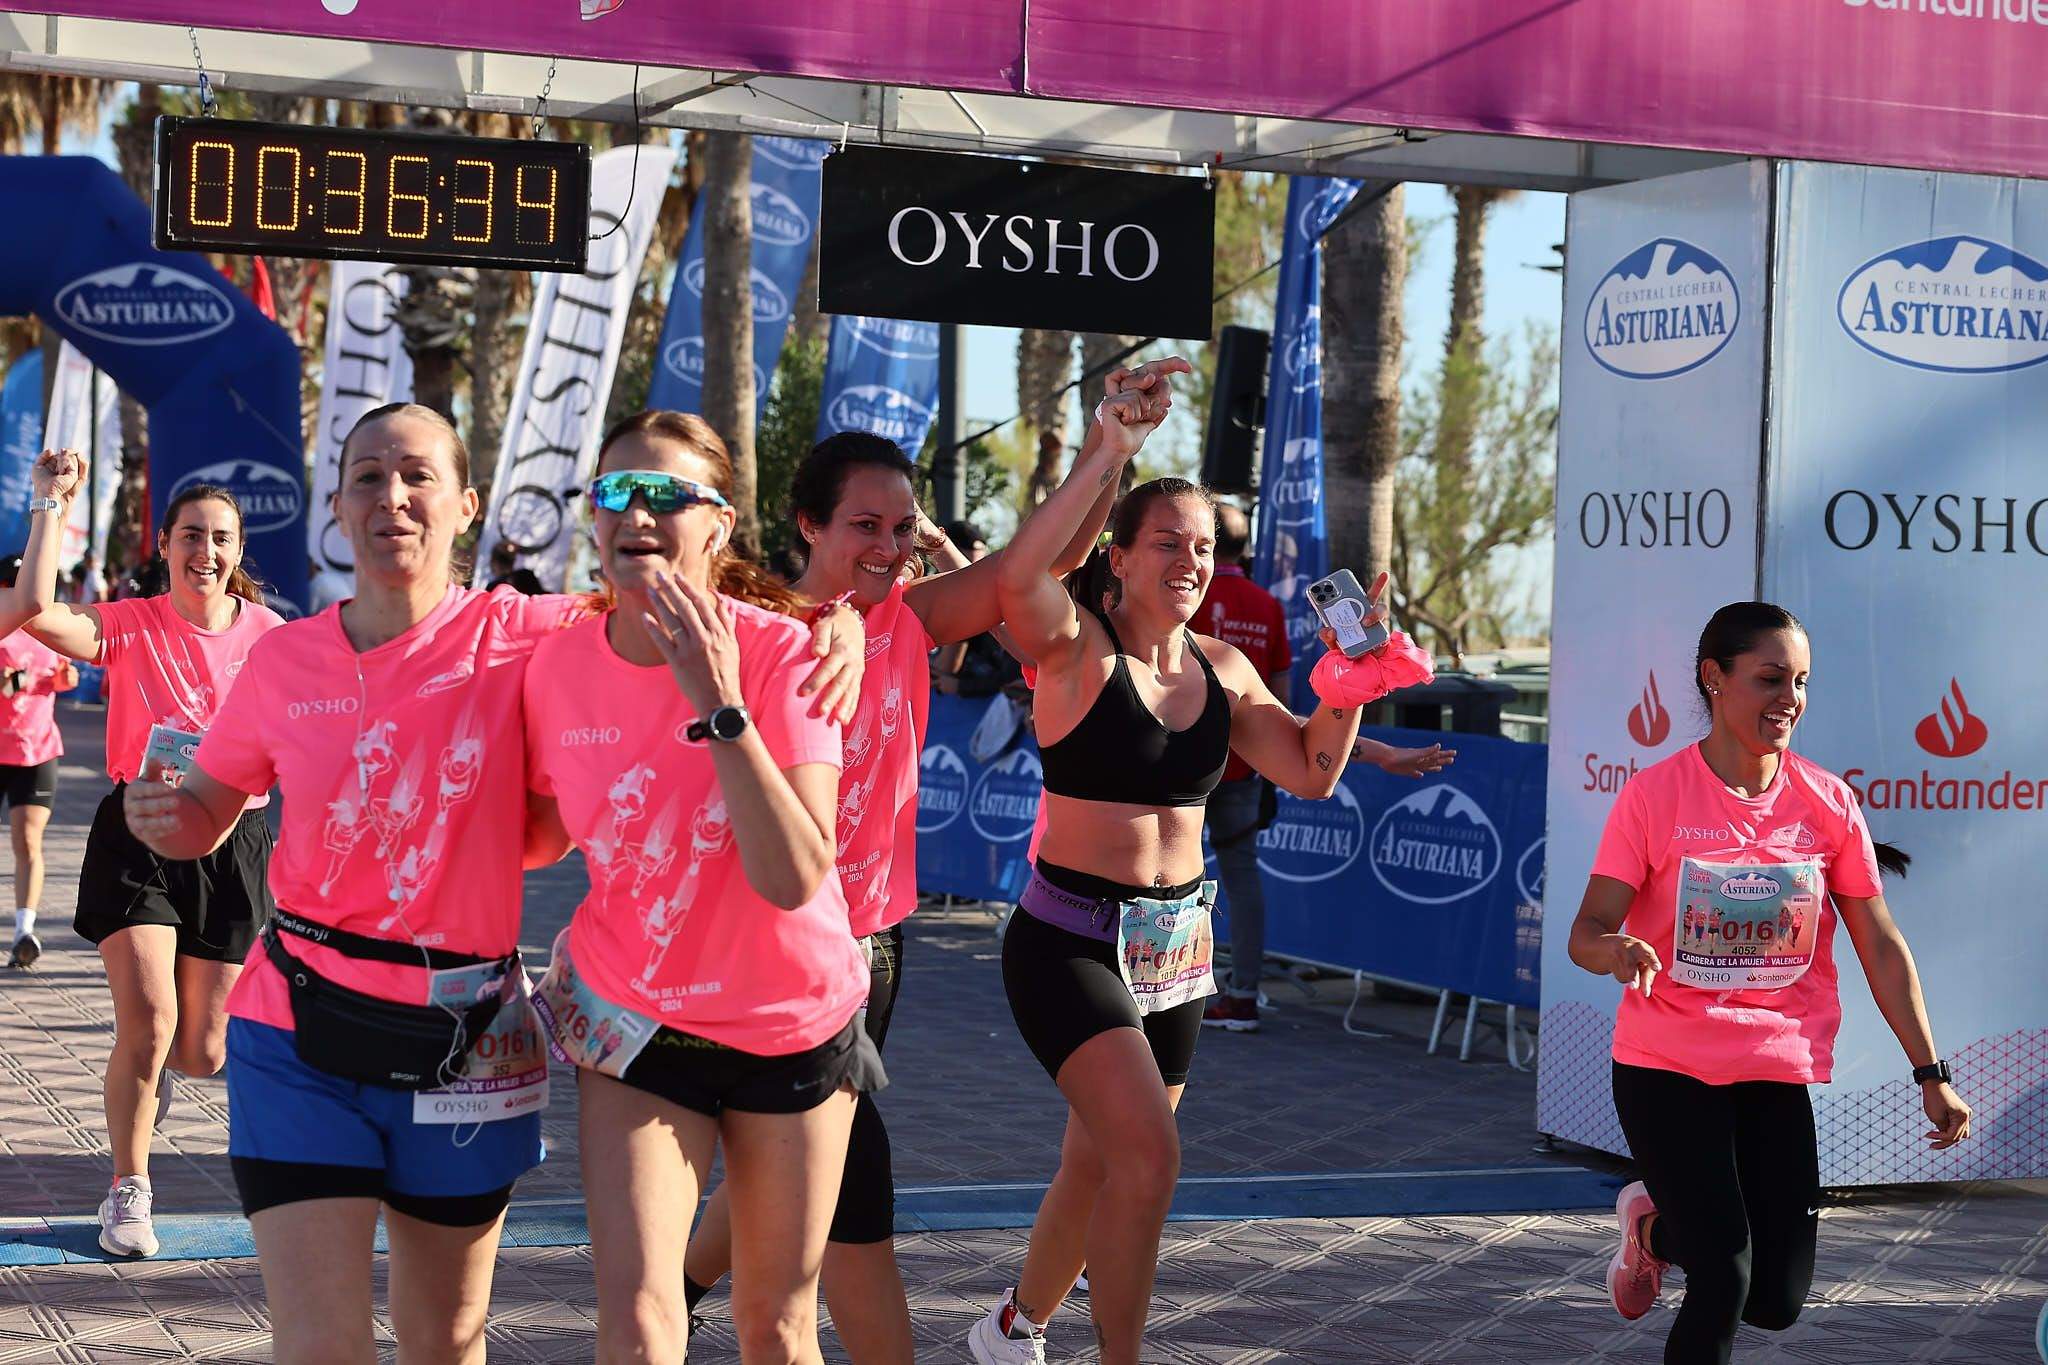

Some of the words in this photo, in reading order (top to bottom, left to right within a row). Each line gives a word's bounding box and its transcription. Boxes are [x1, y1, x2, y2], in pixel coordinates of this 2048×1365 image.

[191, 141, 557, 245] 00:36:34
[887, 206, 1160, 283] OYSHO
[1617, 288, 1664, 305] CENTRAL
[1669, 281, 1723, 298] LECHERA
[1894, 280, 1975, 298] CENTRAL
[71, 293, 223, 325] ASTURIANA
[1594, 297, 1727, 347] ASTURIANA
[500, 210, 631, 555] OYSHO
[1580, 488, 1731, 549] OYSHO
[288, 696, 359, 720] OYSHO
[560, 726, 622, 747] OYSHO
[1376, 821, 1484, 880] ASTURIANA
[1724, 882, 1777, 895] ASTURIANA
[1722, 920, 1775, 941] 016
[1682, 953, 1715, 966] CARRERA
[1717, 957, 1727, 966] DE
[1729, 957, 1738, 966] LA
[1740, 957, 1765, 966] MUJER
[1771, 956, 1804, 965] VALENCIA
[1732, 945, 1757, 955] 4052
[1687, 969, 1731, 983] OYSHO
[476, 1031, 524, 1058] 016
